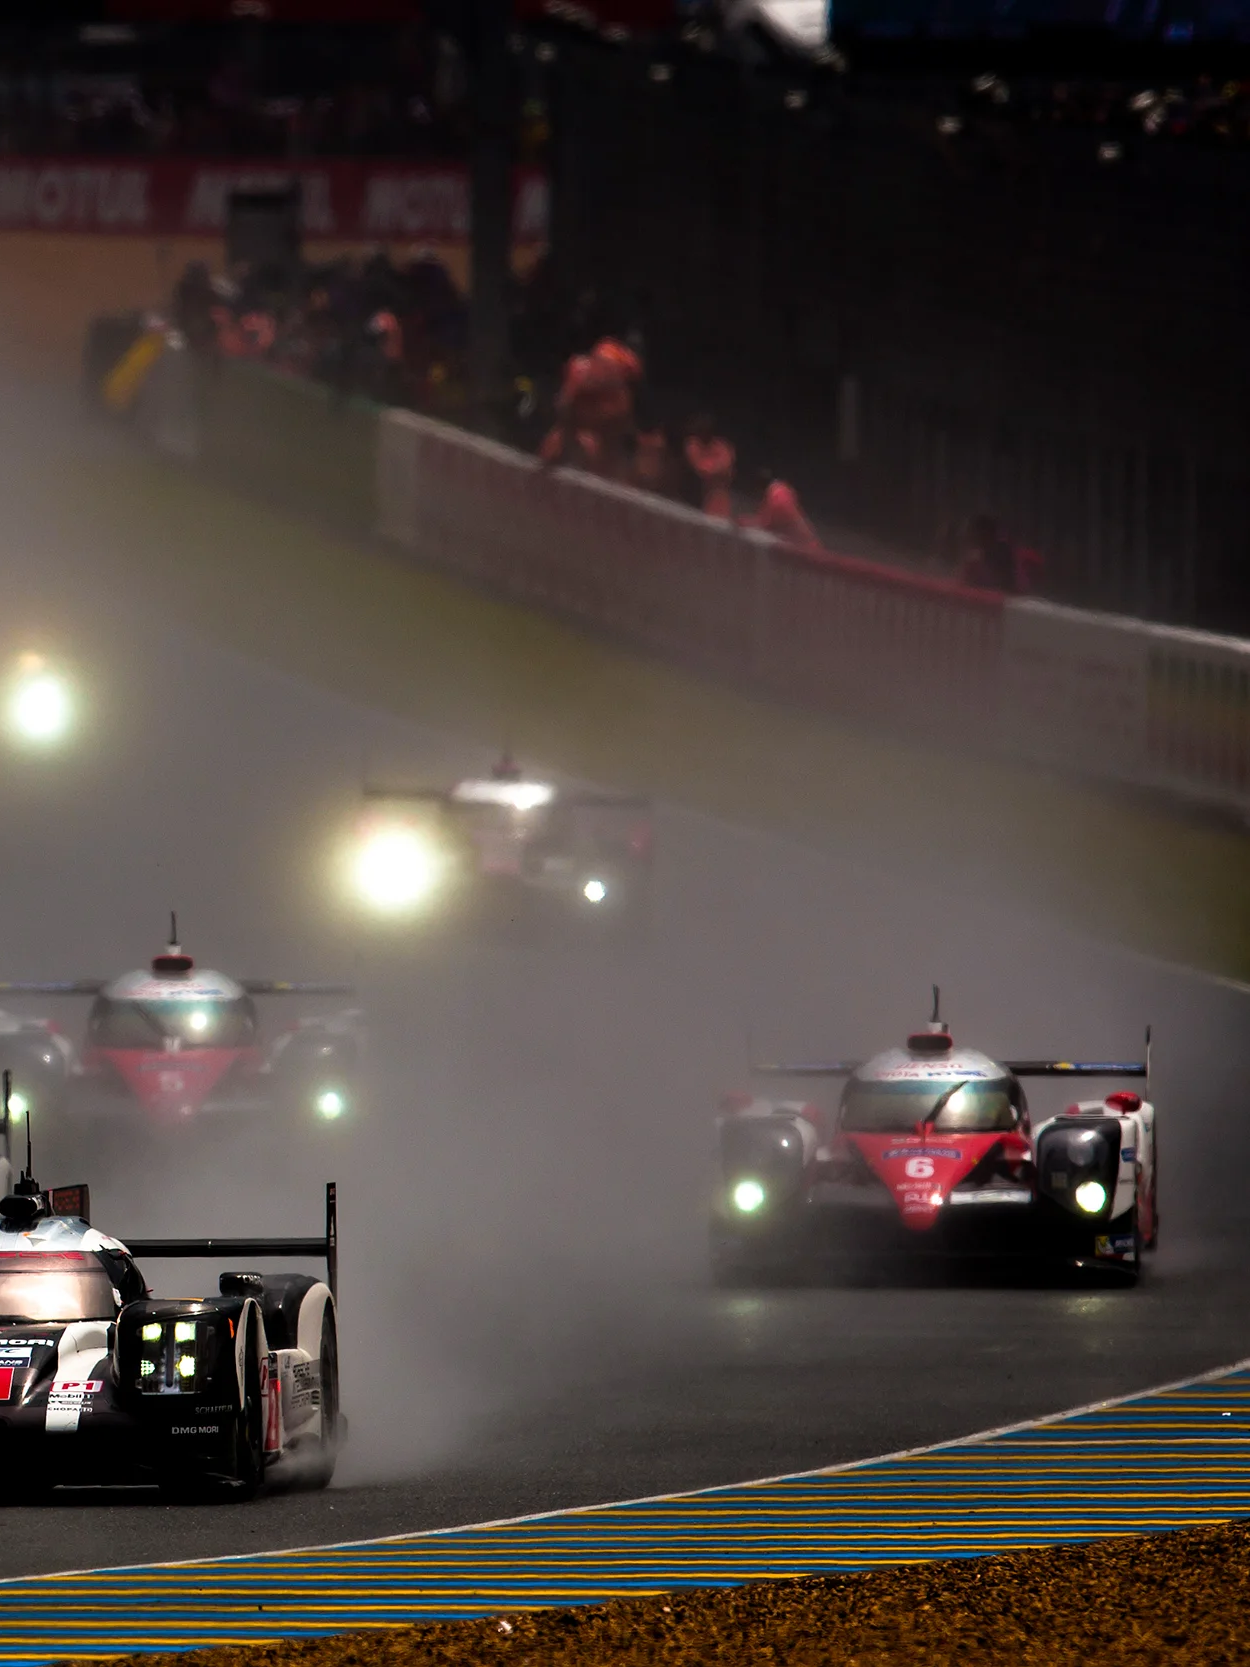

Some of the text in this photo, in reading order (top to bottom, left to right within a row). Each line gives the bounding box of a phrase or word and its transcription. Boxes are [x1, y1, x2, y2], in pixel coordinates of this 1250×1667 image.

[905, 1157, 935, 1179] 6
[61, 1382, 95, 1391] P1
[171, 1425, 220, 1435] DMG MORI
